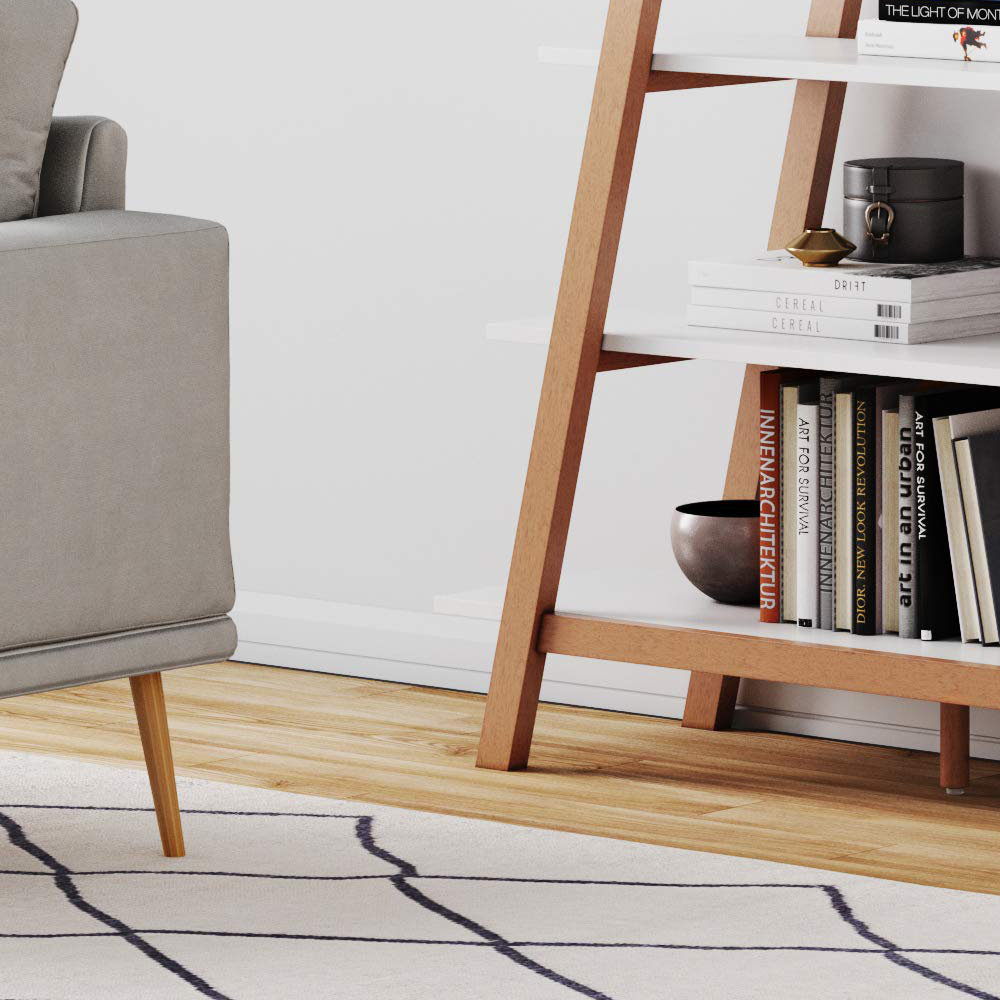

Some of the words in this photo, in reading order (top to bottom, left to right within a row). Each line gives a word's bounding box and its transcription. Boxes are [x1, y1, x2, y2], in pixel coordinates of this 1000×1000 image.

[885, 4, 910, 17] THE
[911, 5, 946, 18] LIGHT
[947, 6, 965, 19] OF
[775, 296, 824, 313] CEREAL
[771, 316, 821, 333] CEREAL
[798, 417, 810, 443] ART
[915, 411, 924, 438] ART
[798, 447, 810, 473] FOR
[857, 400, 867, 497] REVOLUTION
[899, 427, 913, 498] urban
[916, 442, 926, 472] FOR
[760, 408, 776, 610] INNENARCHITEKTUR
[798, 477, 810, 536] SURVIVAL
[820, 392, 833, 593] INNENARCHITEKTUR
[916, 476, 927, 541] SURVIVAL
[857, 500, 866, 542] LOOK
[899, 506, 912, 535] an
[857, 545, 866, 581] NEW
[899, 542, 912, 565] in
[857, 584, 866, 625] DIOR.
[899, 572, 912, 608] art
